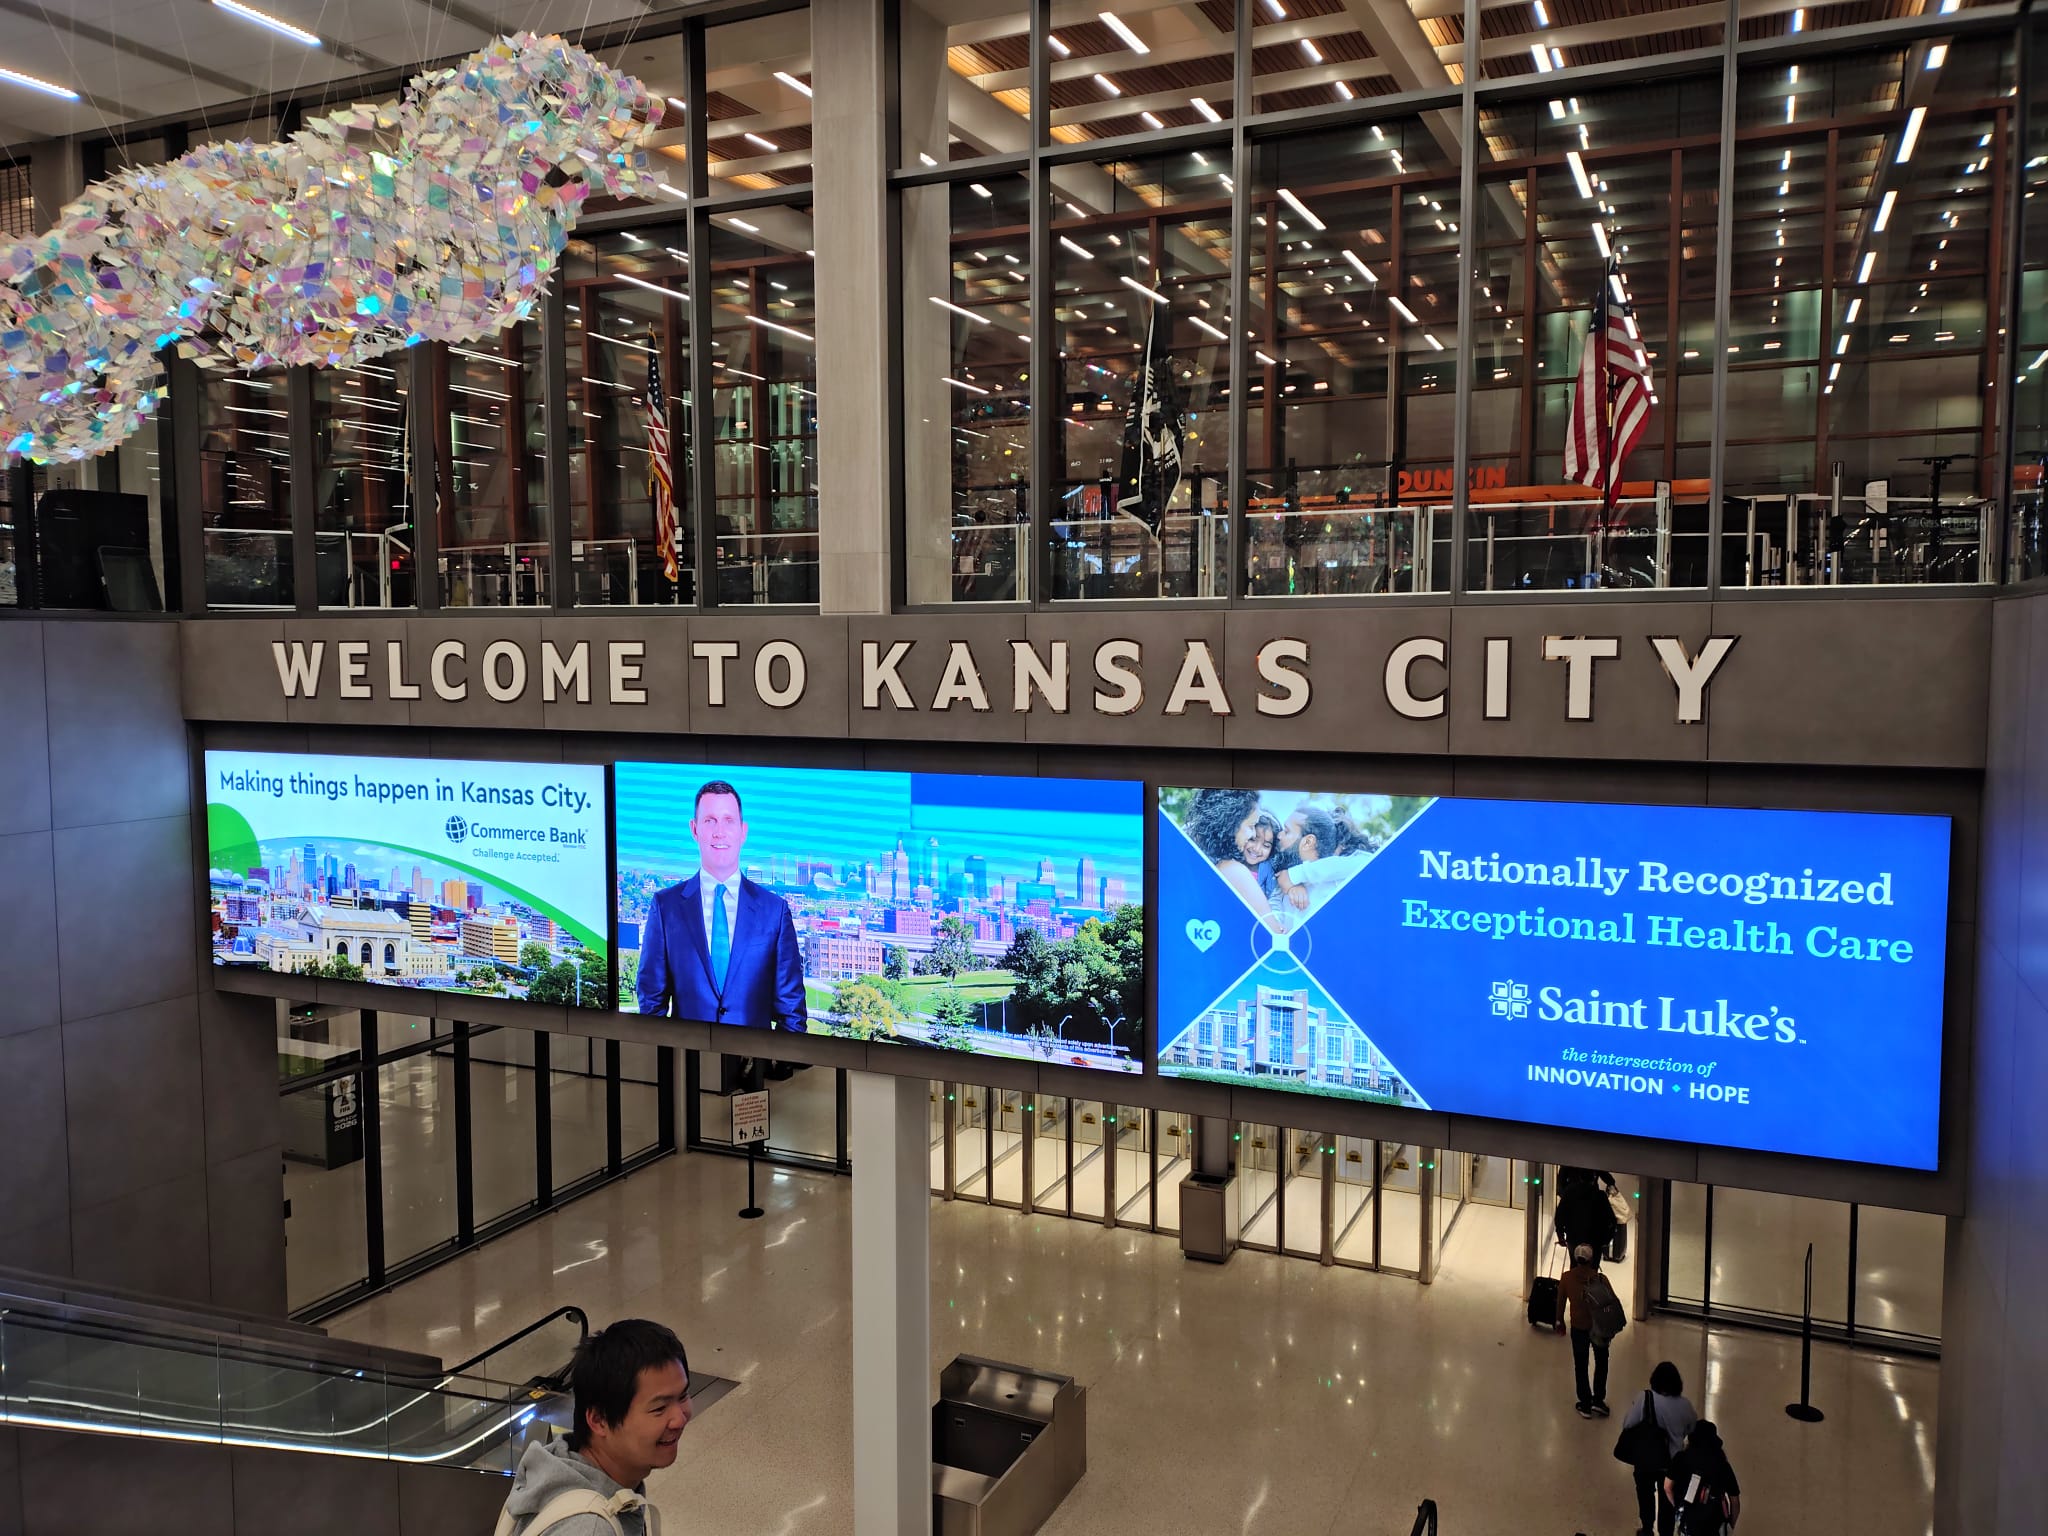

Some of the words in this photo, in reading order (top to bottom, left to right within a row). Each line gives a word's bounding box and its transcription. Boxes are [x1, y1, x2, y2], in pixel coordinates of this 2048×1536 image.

[272, 640, 649, 704] WELCOME
[693, 640, 808, 708] TO
[861, 638, 1312, 718] KANSAS
[1383, 635, 1741, 724] CITY
[220, 770, 284, 798] Making
[289, 771, 348, 801] things
[354, 774, 429, 804] happen
[435, 778, 454, 802] in
[461, 781, 535, 806] Kansas
[541, 783, 592, 814] City.
[471, 823, 545, 842] Commerce
[549, 827, 586, 844] Bank
[472, 848, 515, 861] Challenge
[516, 852, 560, 863] Accepted.
[1419, 850, 1629, 896] Nationally
[1638, 861, 1894, 905] Recognized
[1193, 927, 1212, 940] KC
[1401, 898, 1636, 944] Exceptional
[1646, 915, 1794, 955] Health
[1806, 926, 1914, 963] Care
[1538, 986, 1649, 1030] Saint
[1658, 996, 1797, 1044] Luke's
[1562, 1047, 1588, 1063] the
[1591, 1050, 1694, 1074] intersection
[1697, 1061, 1717, 1078] of
[1527, 1064, 1664, 1095] INNOVATION
[1689, 1082, 1750, 1105] HOPE
